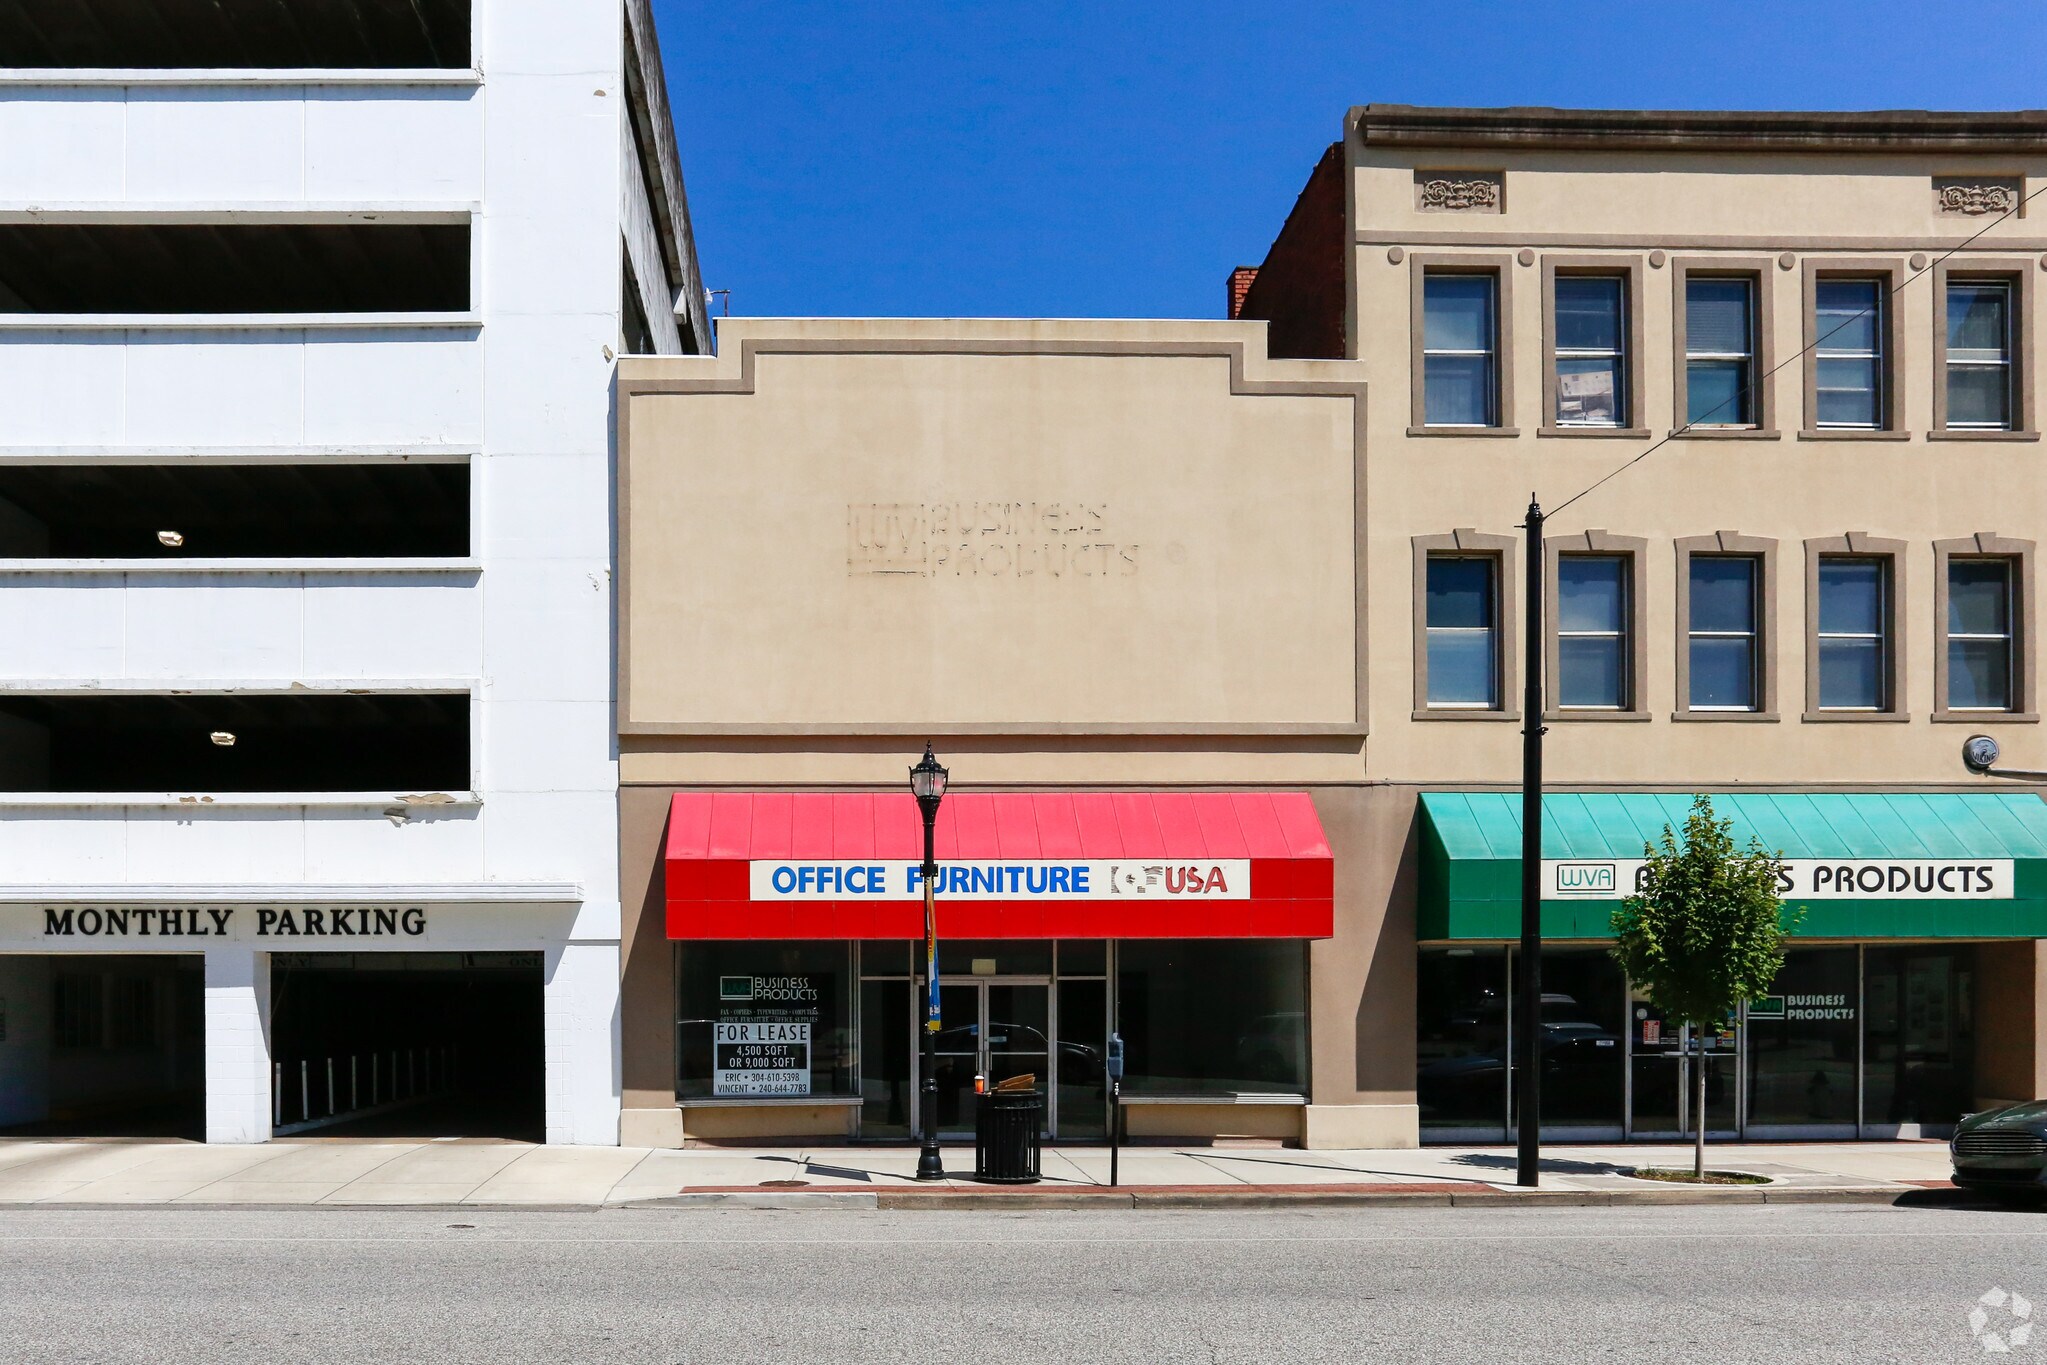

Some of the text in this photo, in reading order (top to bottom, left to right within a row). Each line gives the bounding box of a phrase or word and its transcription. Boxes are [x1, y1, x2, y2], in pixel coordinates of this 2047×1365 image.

[773, 866, 1228, 893] OFFICE FURNITURE USA
[1561, 869, 1611, 887] WVA
[1814, 866, 1994, 892] PRODUCTS
[44, 908, 427, 935] MONTHLY PARKING
[754, 977, 809, 989] BUSINESS
[754, 989, 818, 1001] PRODUCTS
[1787, 994, 1845, 1006] BUSINESS
[1787, 1008, 1854, 1020] PRODUCTS
[717, 1025, 807, 1040] FOR LEASE
[736, 1046, 788, 1057] 4,500 SQFT
[729, 1058, 796, 1068] OR 9,000 SQFT
[725, 1073, 800, 1082] ERIC 304-610-5398
[718, 1084, 807, 1093] VINCENT 240-644-7783
